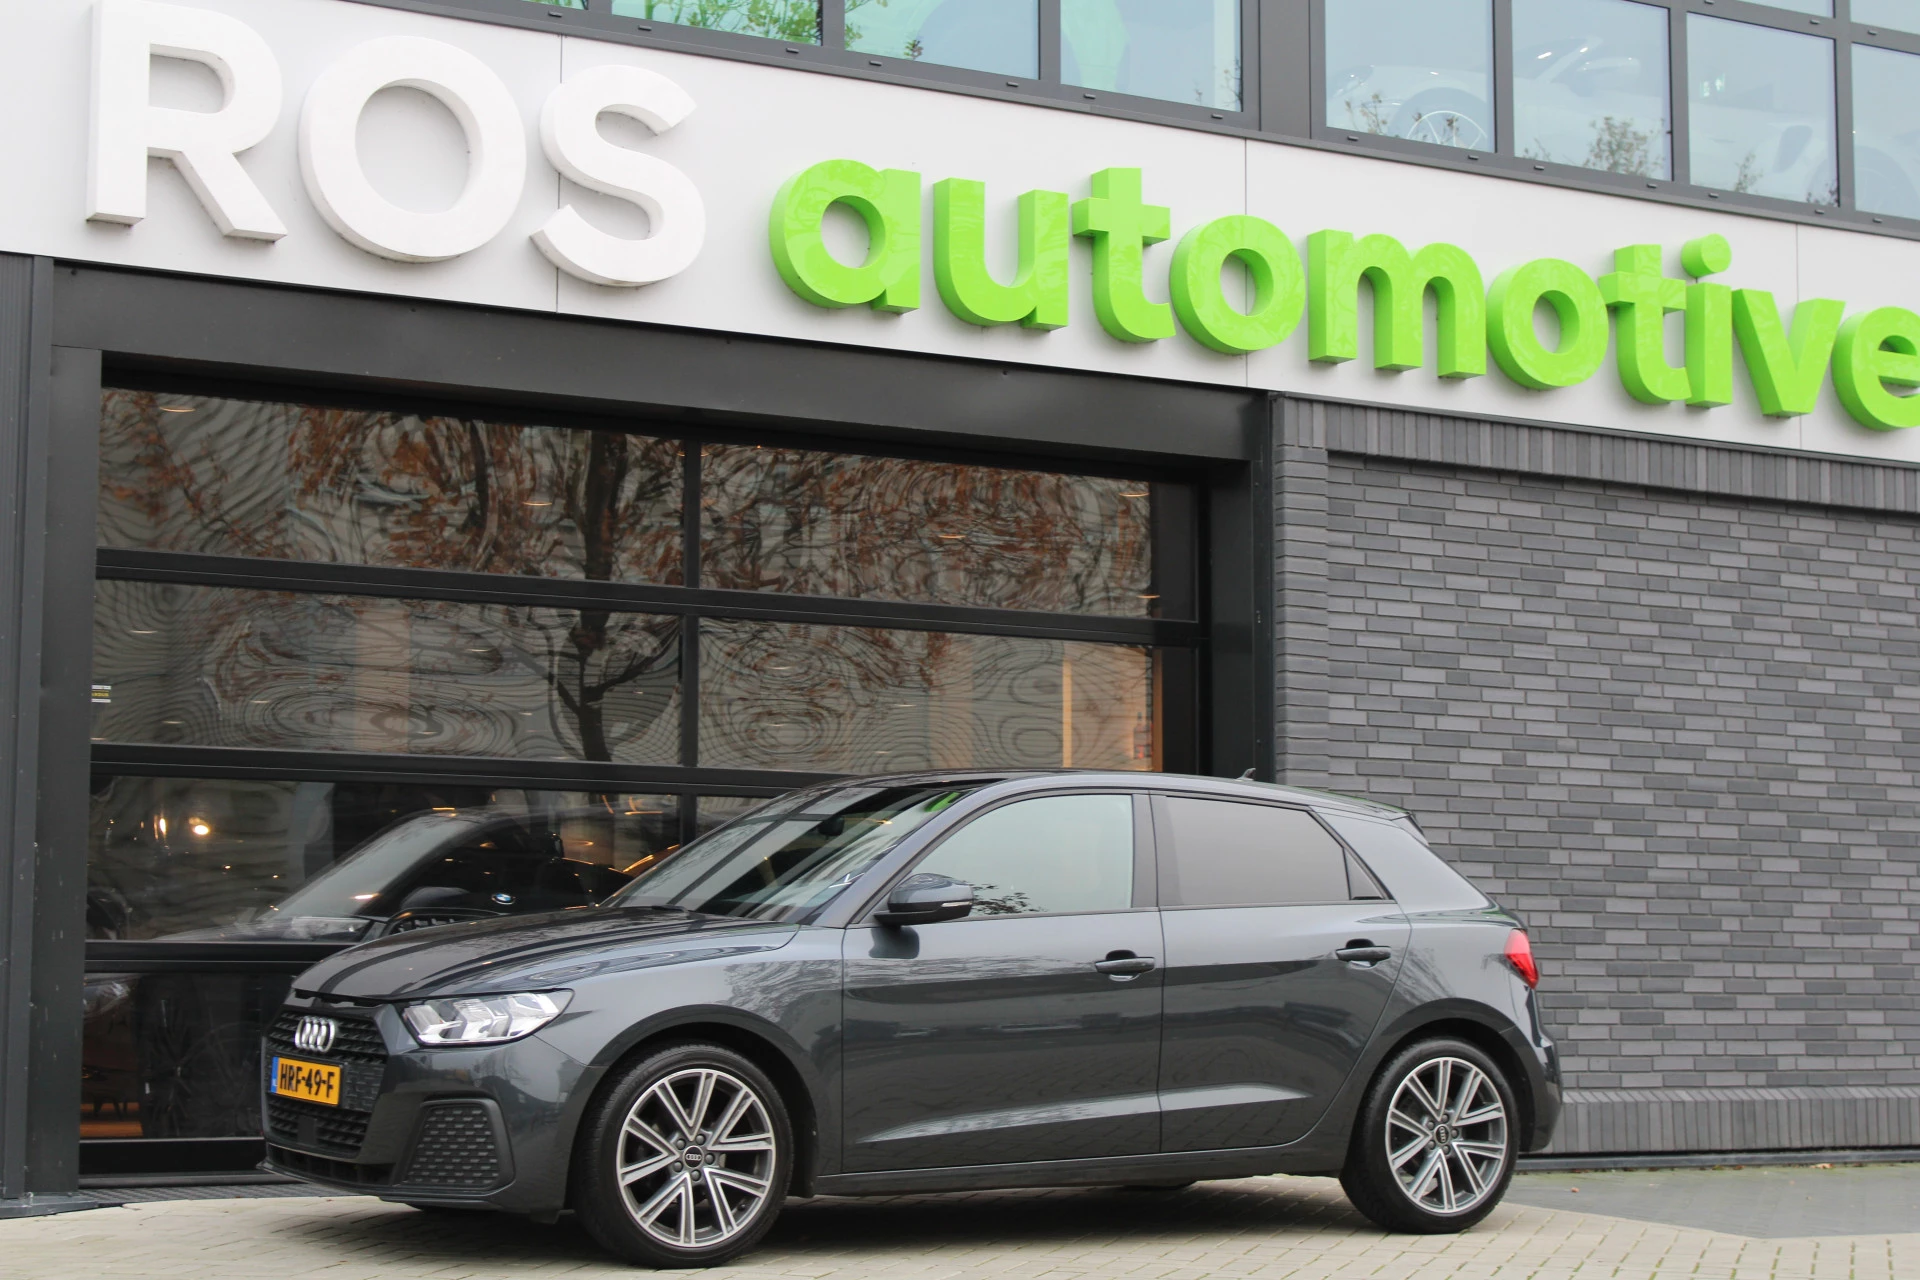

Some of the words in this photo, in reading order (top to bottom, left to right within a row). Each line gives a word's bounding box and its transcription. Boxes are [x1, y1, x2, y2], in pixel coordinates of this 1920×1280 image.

[86, 0, 706, 288] ROS
[769, 158, 1920, 431] automotive
[280, 1063, 335, 1098] HRF-49-F
